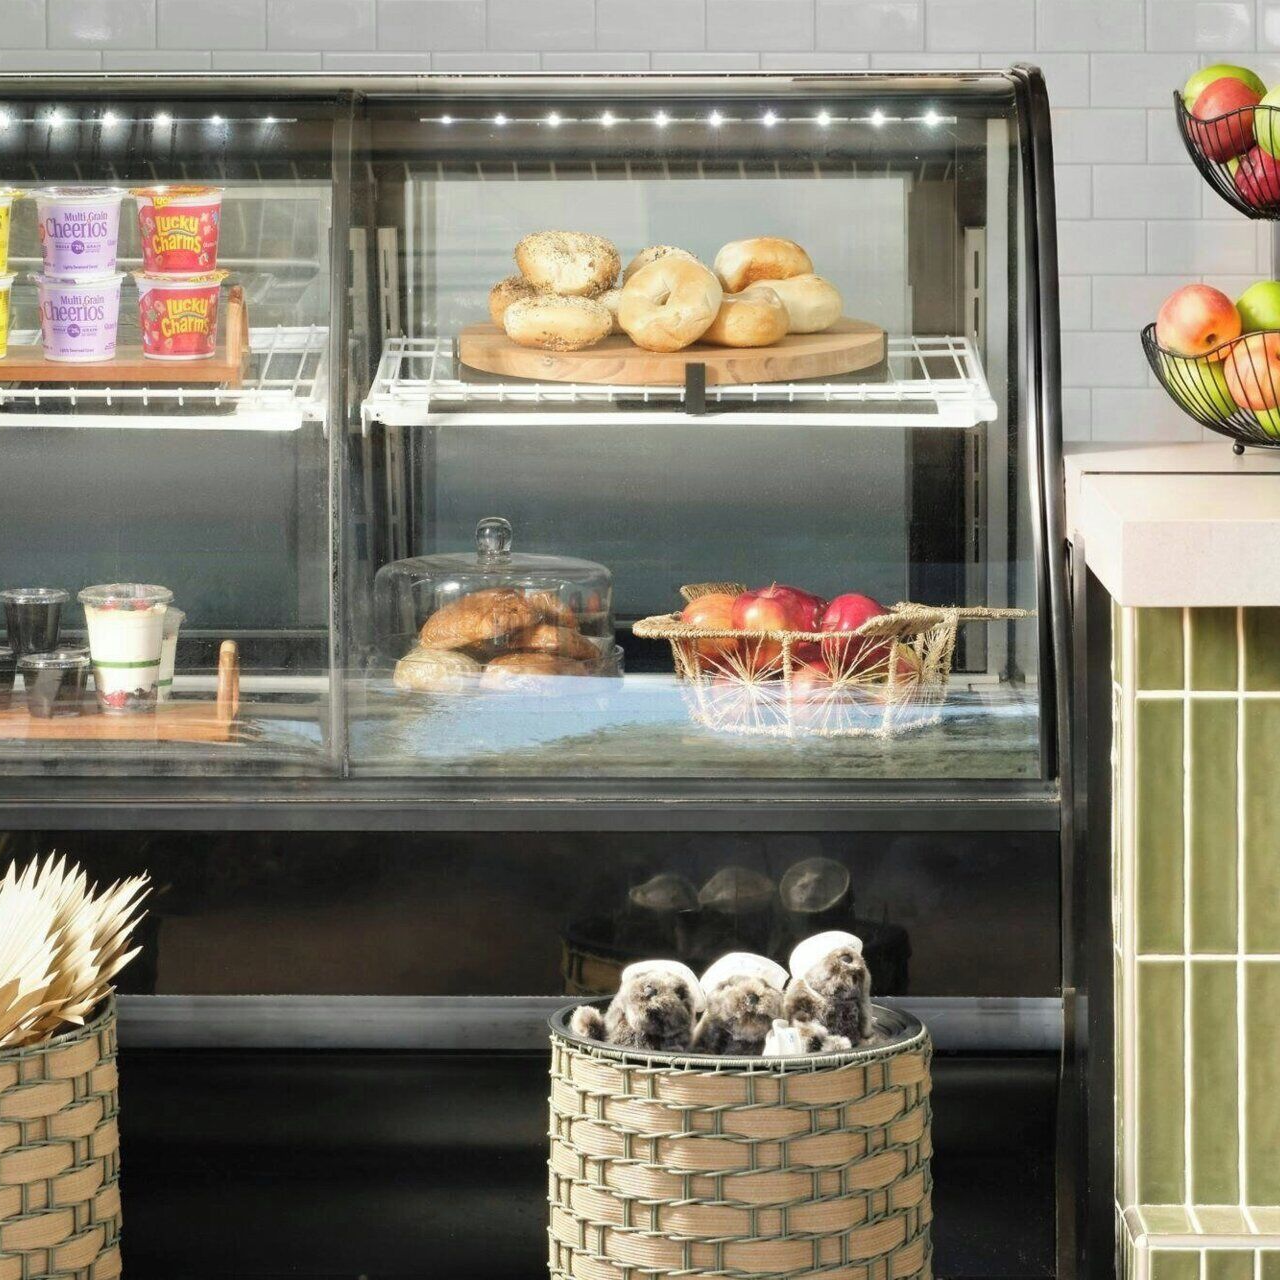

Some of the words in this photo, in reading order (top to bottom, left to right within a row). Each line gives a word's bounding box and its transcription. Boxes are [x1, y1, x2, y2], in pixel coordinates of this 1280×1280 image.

[64, 212, 86, 221] Multi
[87, 212, 107, 222] Grain
[45, 218, 107, 239] Cheerios
[152, 234, 202, 255] Charms
[60, 295, 82, 304] Multi
[83, 295, 104, 306] Grain
[43, 300, 104, 322] Cheerios
[162, 317, 209, 337] Charms
